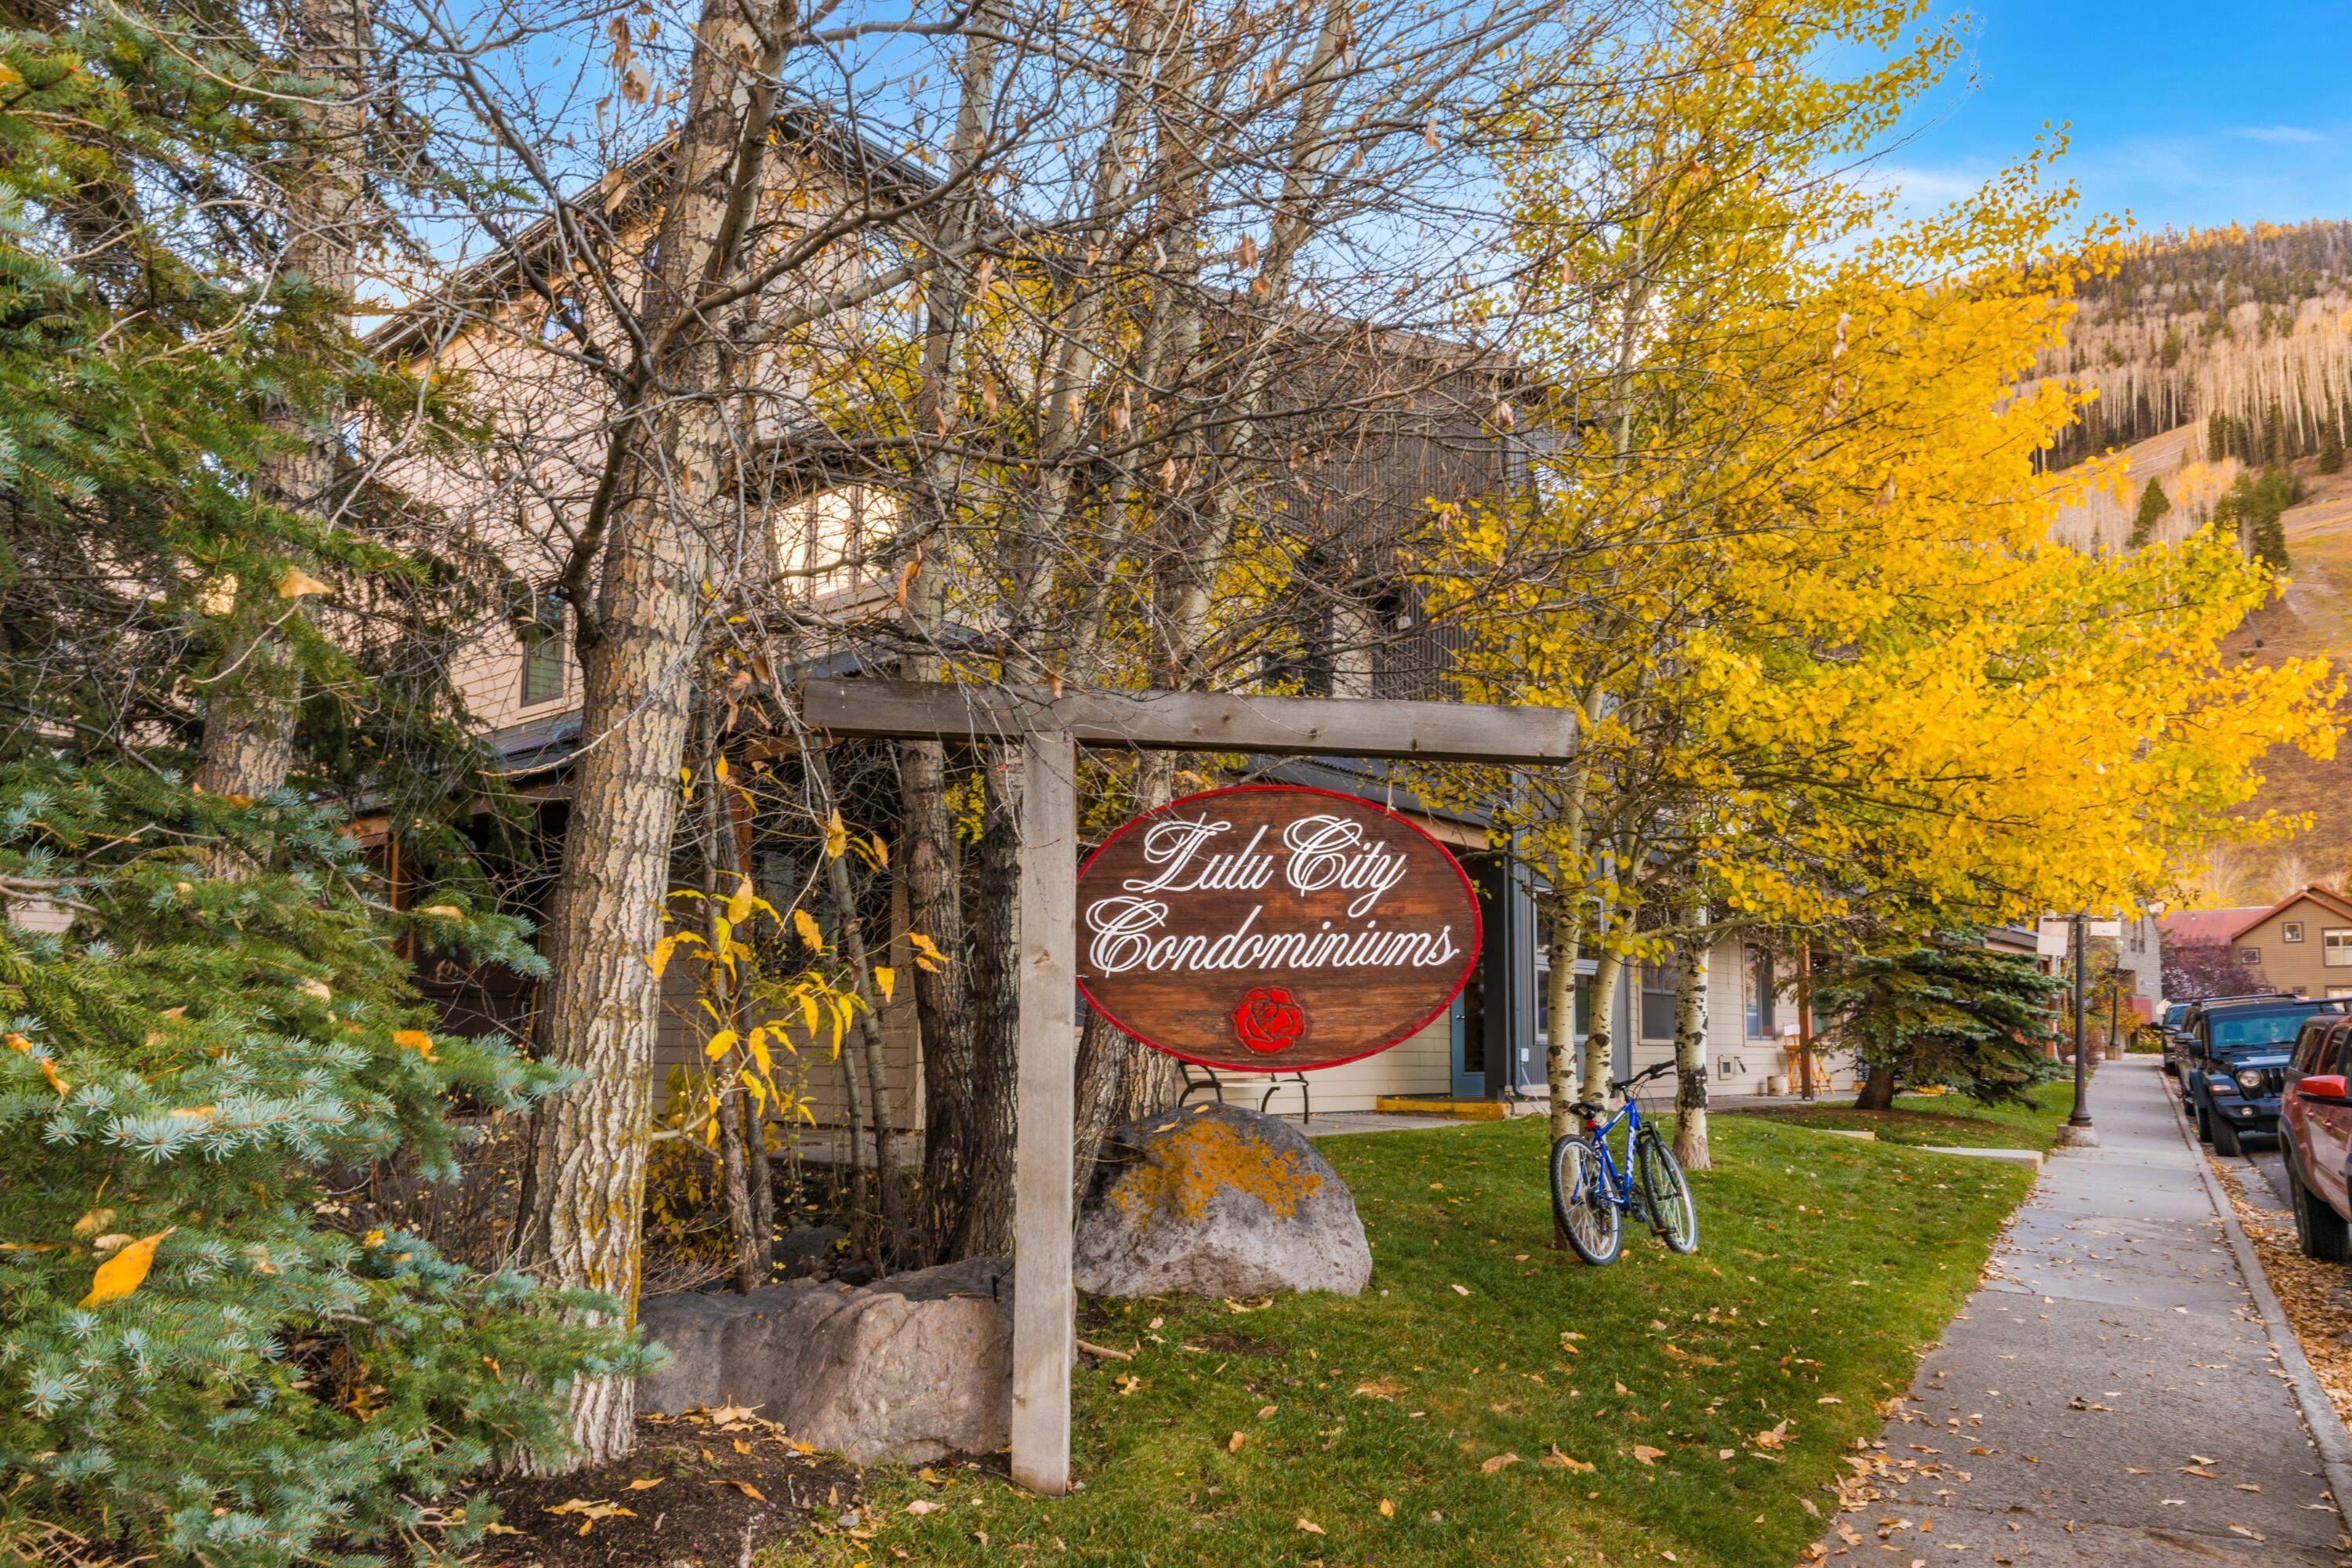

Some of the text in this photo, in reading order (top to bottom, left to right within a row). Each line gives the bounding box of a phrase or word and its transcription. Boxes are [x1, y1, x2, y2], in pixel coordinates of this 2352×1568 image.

[1123, 812, 1406, 918] Lulu City
[1085, 896, 1461, 978] Condominiums
